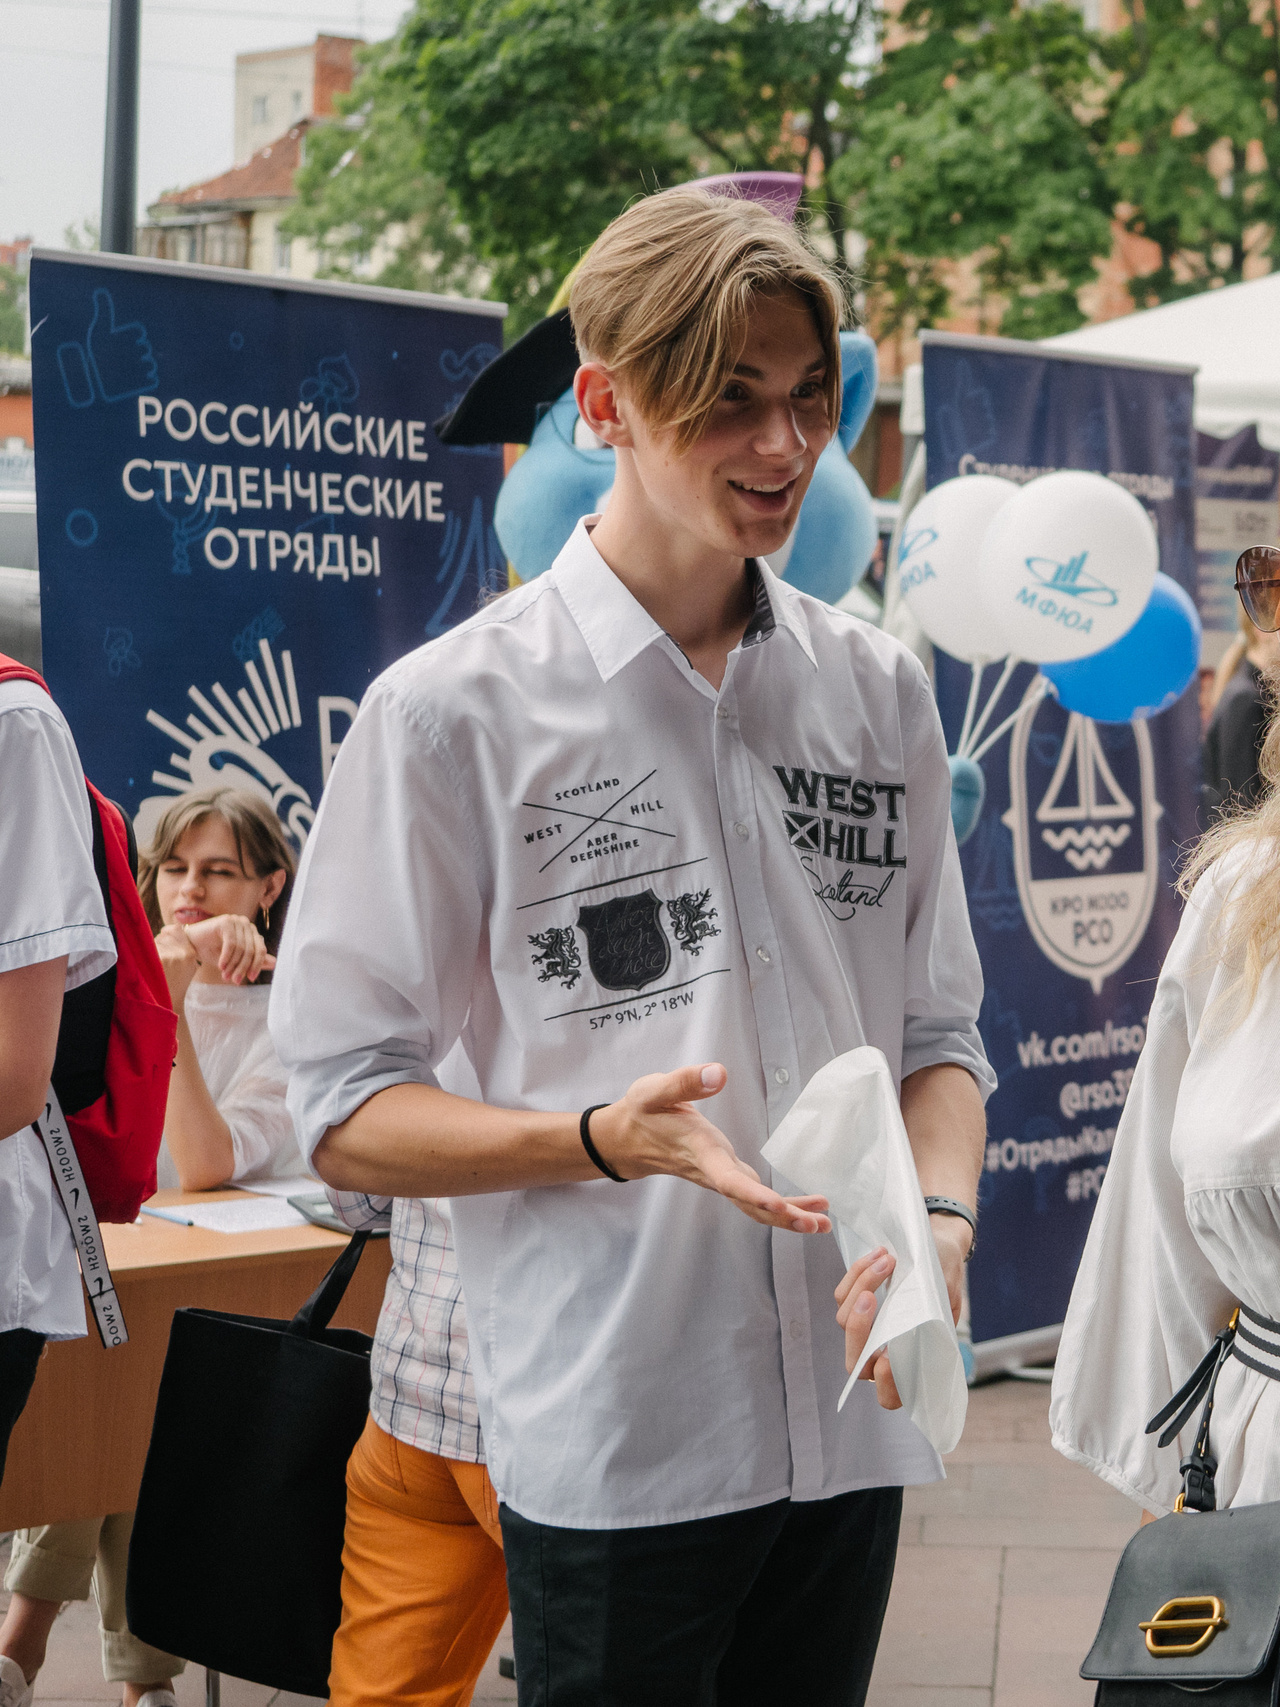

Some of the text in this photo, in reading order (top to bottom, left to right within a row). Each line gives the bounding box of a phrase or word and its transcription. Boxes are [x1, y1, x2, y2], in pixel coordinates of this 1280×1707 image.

[138, 395, 429, 462] РОССИЙСКИЕ
[122, 458, 446, 522] СТУДЕНЧЕСКИЕ
[204, 527, 381, 582] ОТРЯДЫ
[1016, 586, 1094, 634] МФЮА
[555, 778, 620, 801] SCOTLAND
[772, 765, 906, 822] WEST
[524, 800, 664, 844] WEST HILL
[586, 832, 618, 848] ABER
[822, 817, 907, 868] HILL
[570, 839, 640, 864] DEENSHIRE
[800, 856, 895, 921] Scotland
[1073, 918, 1113, 947] РСО
[1017, 1014, 1149, 1069] vk.com/rso
